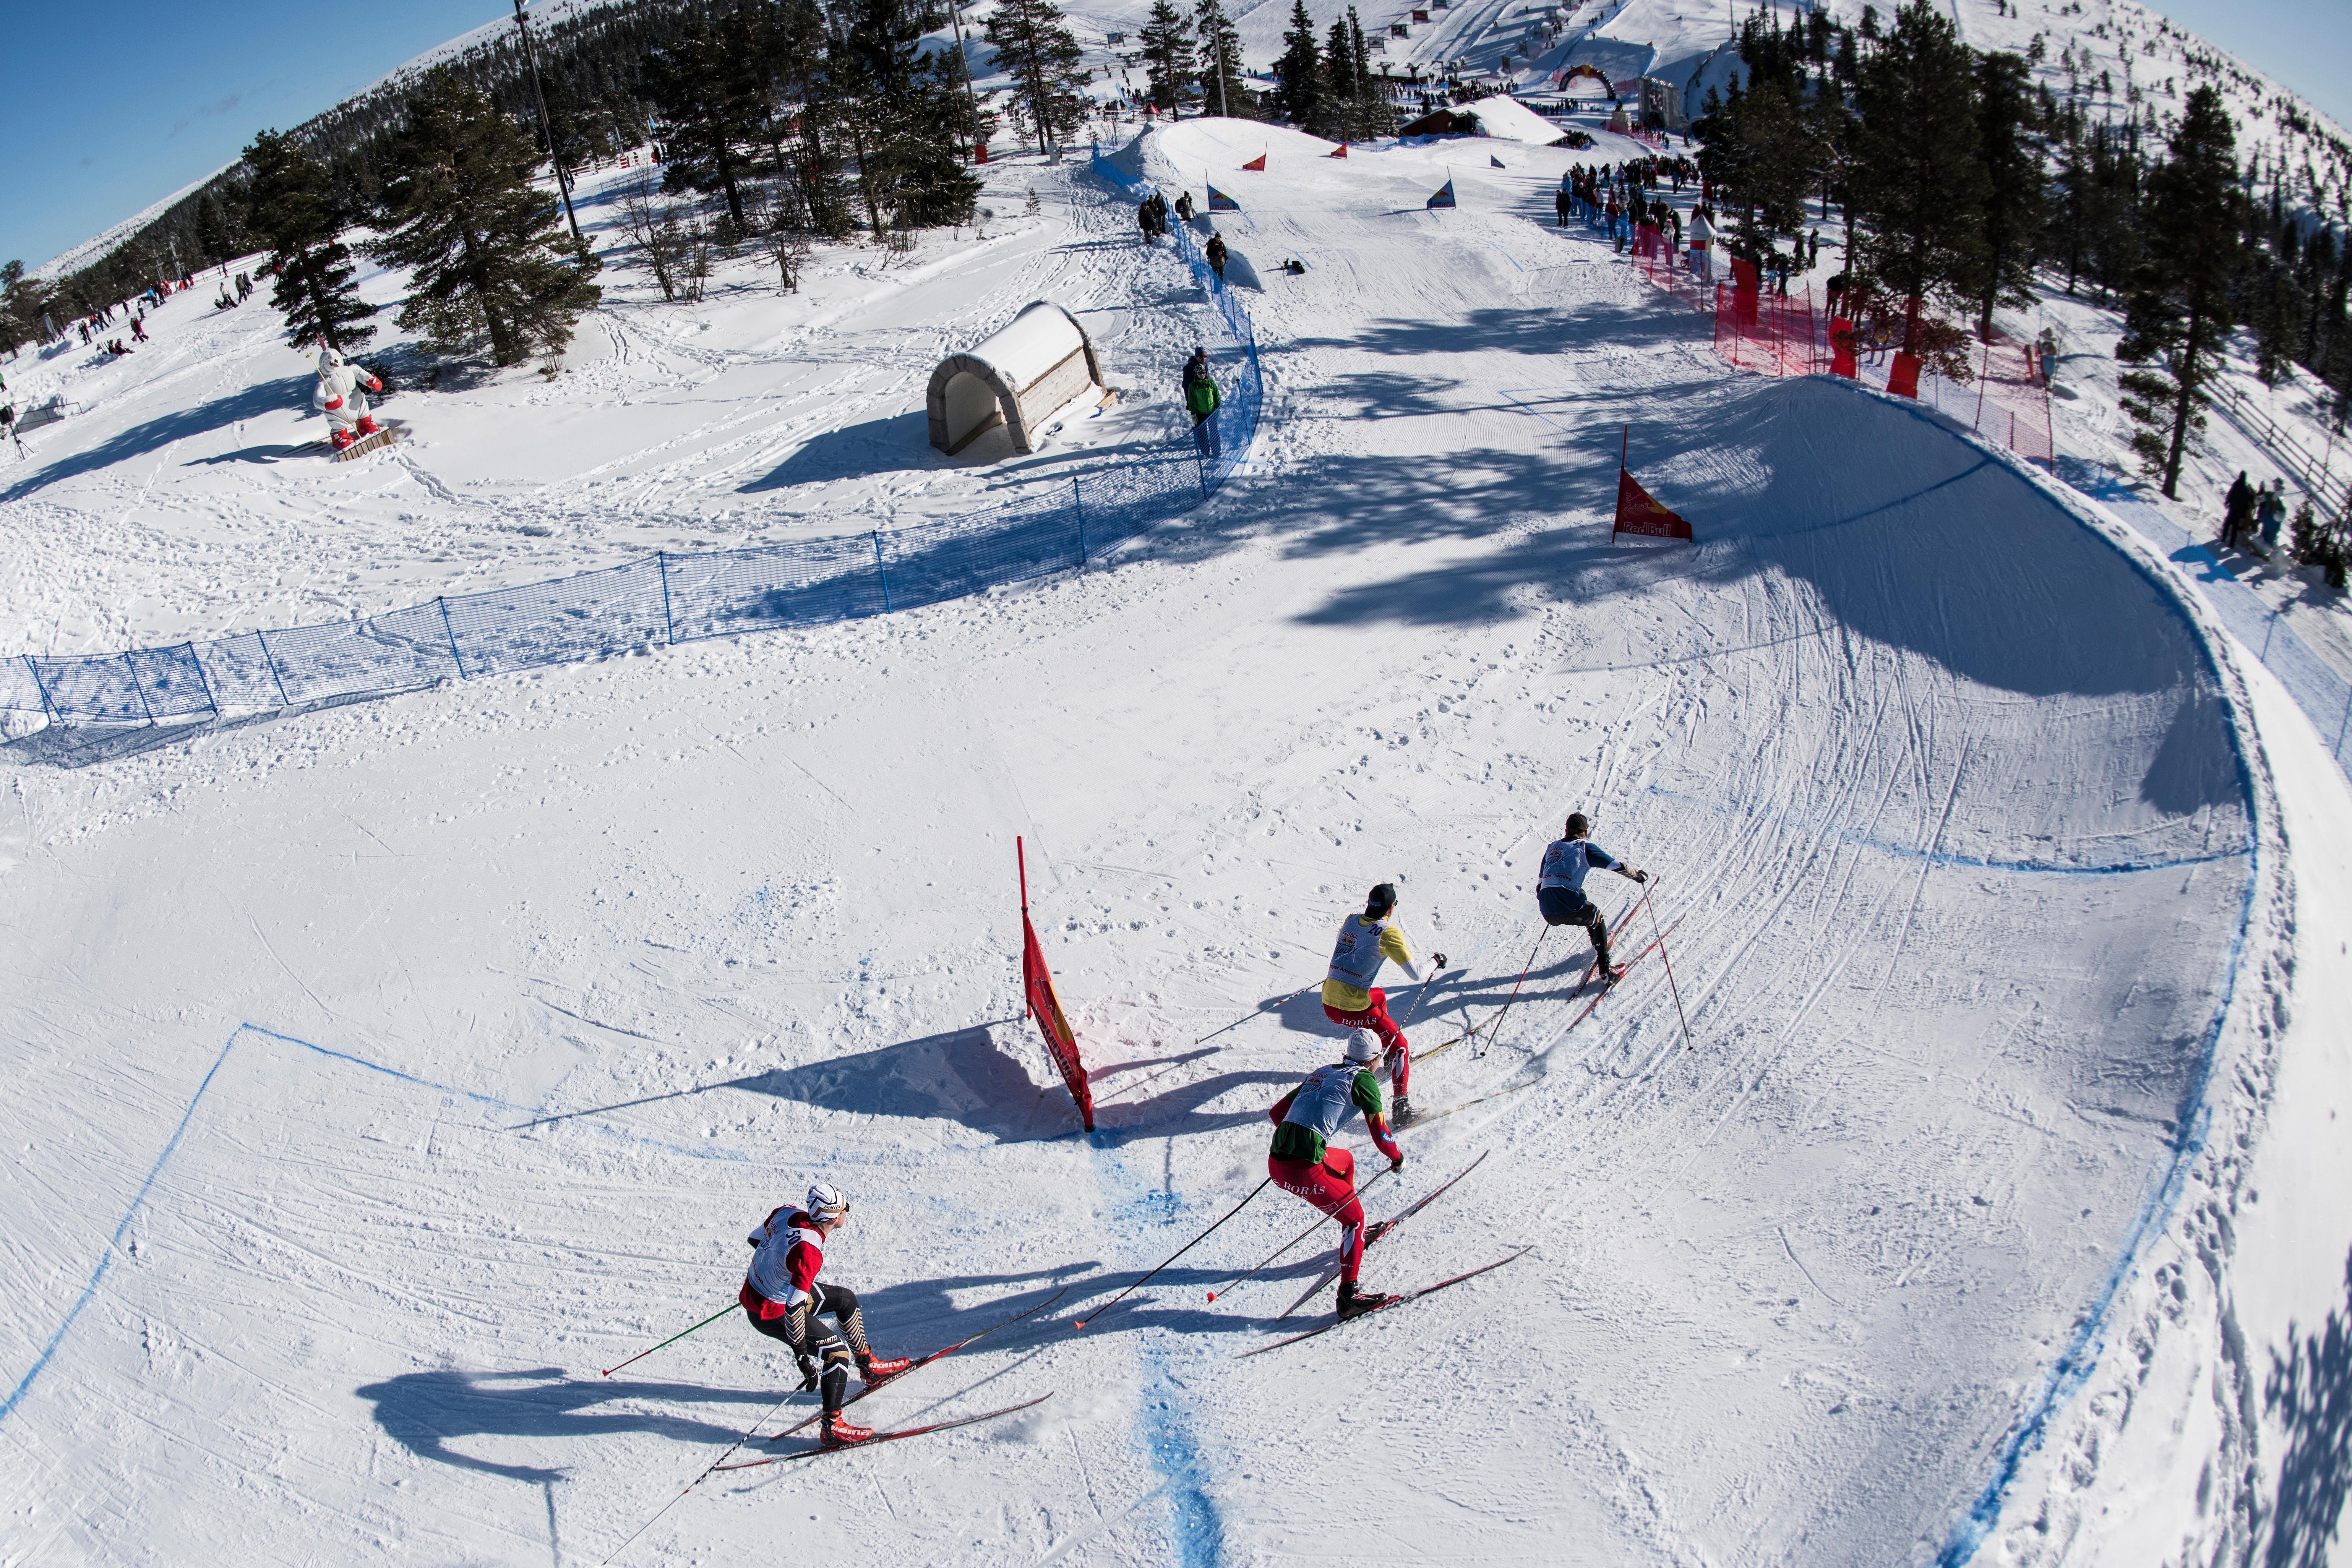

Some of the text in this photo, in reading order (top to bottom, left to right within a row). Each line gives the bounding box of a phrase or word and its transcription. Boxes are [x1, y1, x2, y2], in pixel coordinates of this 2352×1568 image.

[1624, 522, 1671, 536] Red Bull
[1554, 873, 1572, 882] Törning
[1367, 924, 1383, 936] 20
[1340, 967, 1363, 979] Arnesson
[1342, 1015, 1376, 1026] BORÅS
[1341, 1067, 1359, 1076] 62
[1284, 1181, 1325, 1195] BORÅS
[785, 1230, 802, 1245] 50
[816, 1335, 839, 1346] TRIMTEX
[868, 1360, 905, 1369] alpina
[880, 1365, 916, 1387] PELTONEN
[839, 1438, 879, 1450] PELTONEN
